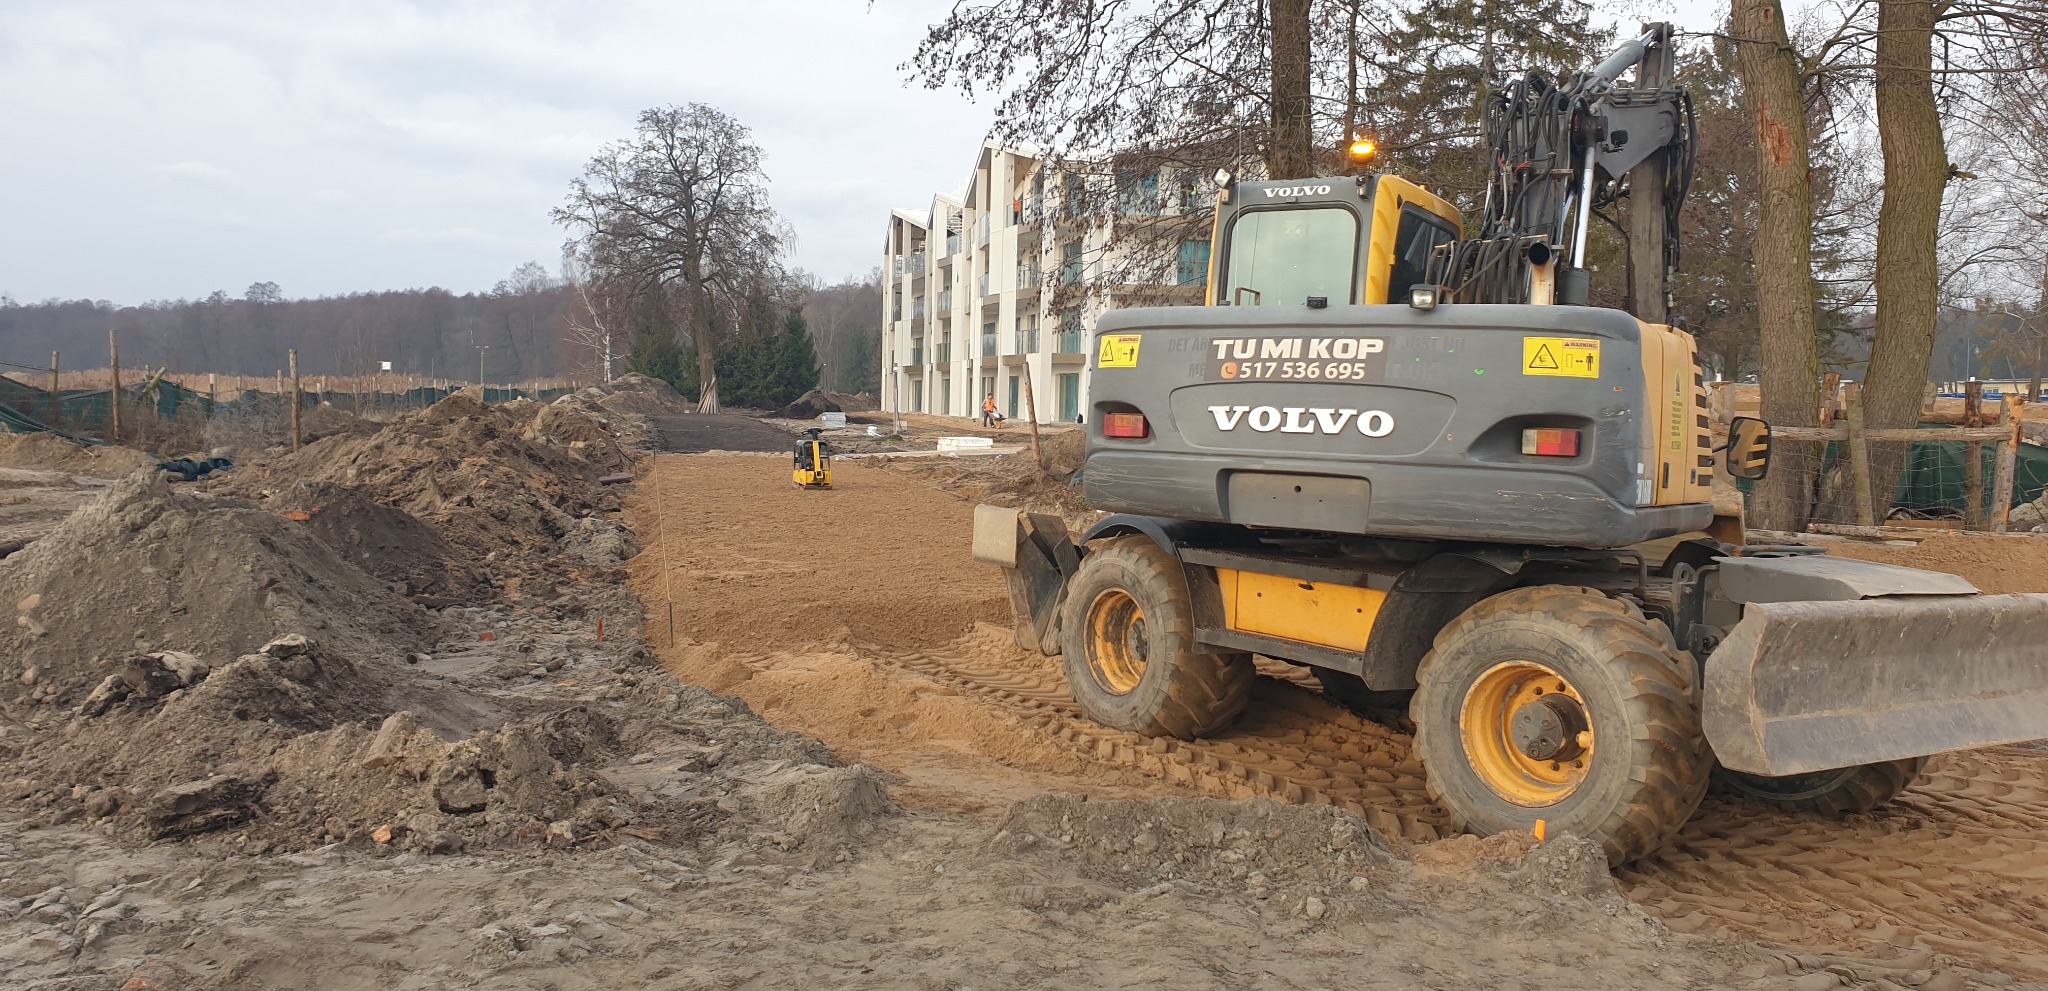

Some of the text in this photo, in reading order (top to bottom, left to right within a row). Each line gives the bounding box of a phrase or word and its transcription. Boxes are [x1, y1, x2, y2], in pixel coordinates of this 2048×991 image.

[1263, 185, 1331, 198] VOLVO
[1212, 338, 1257, 360] TU
[1260, 338, 1303, 359] MI
[1307, 338, 1384, 360] KOP
[1239, 361, 1366, 380] 517 536 695
[1207, 405, 1395, 438] VOLVO
